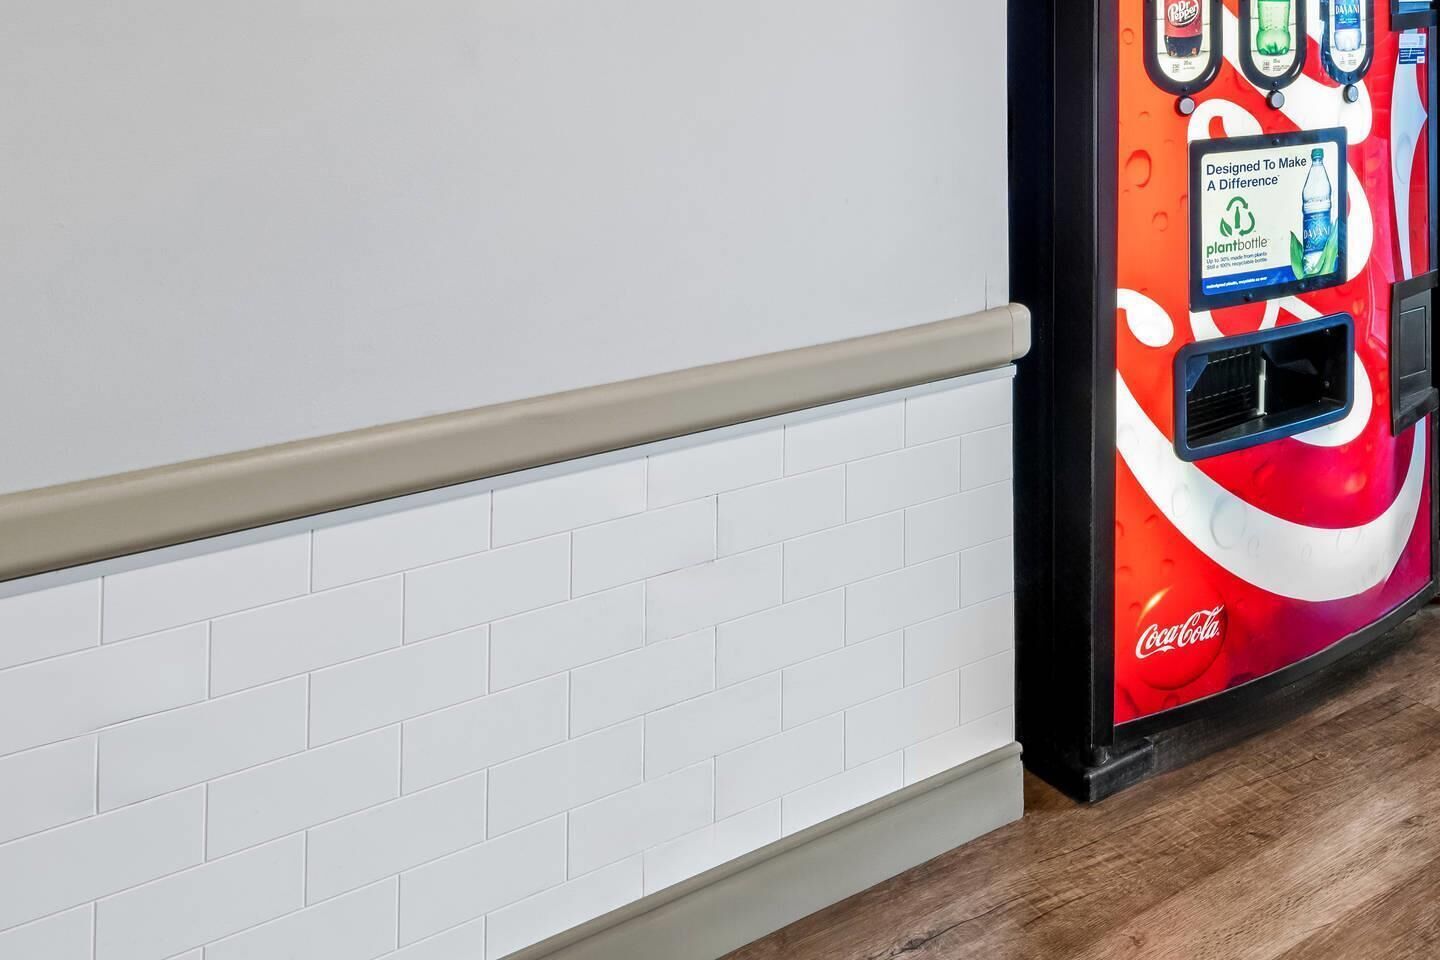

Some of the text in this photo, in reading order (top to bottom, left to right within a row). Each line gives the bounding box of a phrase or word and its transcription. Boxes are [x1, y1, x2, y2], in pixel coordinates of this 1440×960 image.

[1168, 3, 1198, 23] Pepper
[1178, 0, 1191, 11] Dr
[1335, 4, 1360, 15] DASANI
[1206, 156, 1307, 176] Designed To Make
[1206, 175, 1278, 191] A Difference
[1206, 235, 1268, 258] plantbottle
[1136, 604, 1224, 659] Coca-Cola
